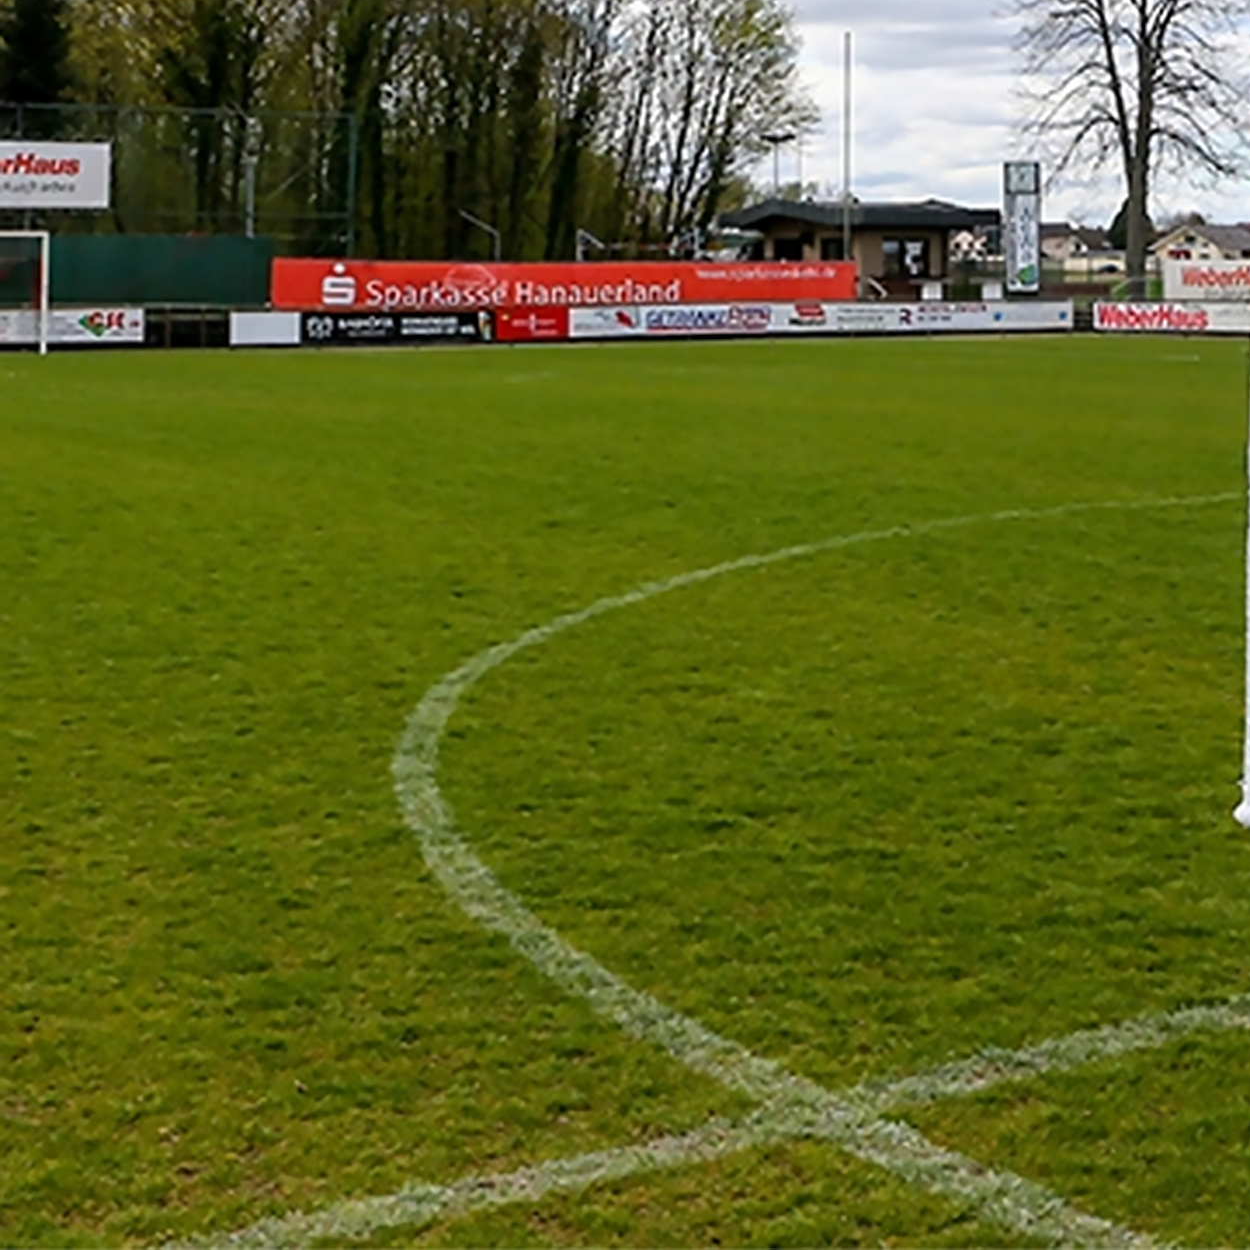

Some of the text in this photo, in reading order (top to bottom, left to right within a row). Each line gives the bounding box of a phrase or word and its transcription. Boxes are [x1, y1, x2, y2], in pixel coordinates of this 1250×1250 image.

[365, 278, 682, 312] Sparkasse Hanauerland
[1098, 304, 1209, 329] WeberHaus
